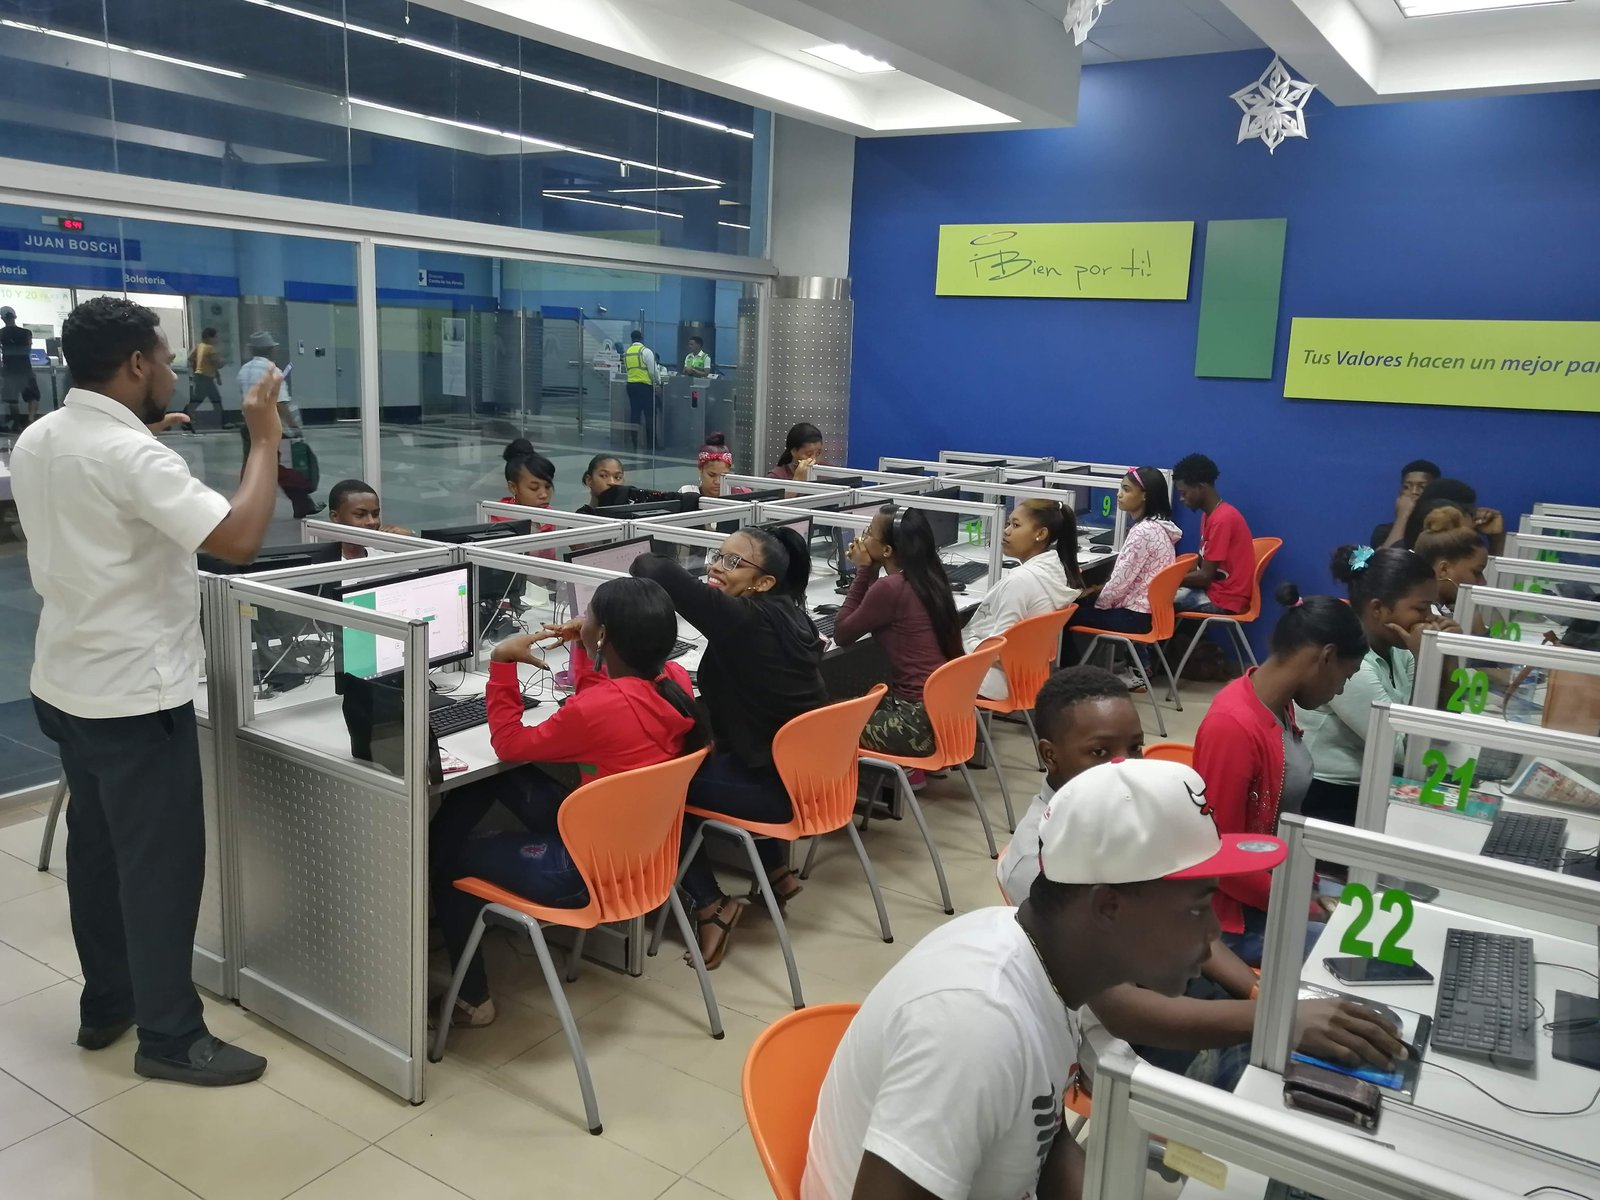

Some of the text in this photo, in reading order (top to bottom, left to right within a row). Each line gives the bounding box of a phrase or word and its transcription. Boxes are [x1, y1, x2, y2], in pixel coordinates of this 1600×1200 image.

[25, 235, 118, 254] JUAN BOSCH
[1074, 265, 1112, 290] por
[1120, 248, 1152, 278] ti!
[1303, 349, 1331, 365] Tus
[1337, 350, 1402, 367] Valores
[1406, 352, 1465, 370] hacen
[1470, 357, 1496, 370] un
[1500, 355, 1564, 376] mejor
[1102, 496, 1111, 517] 9
[1446, 668, 1489, 714] 20
[1418, 748, 1478, 813] 21
[1338, 882, 1415, 967] 22
